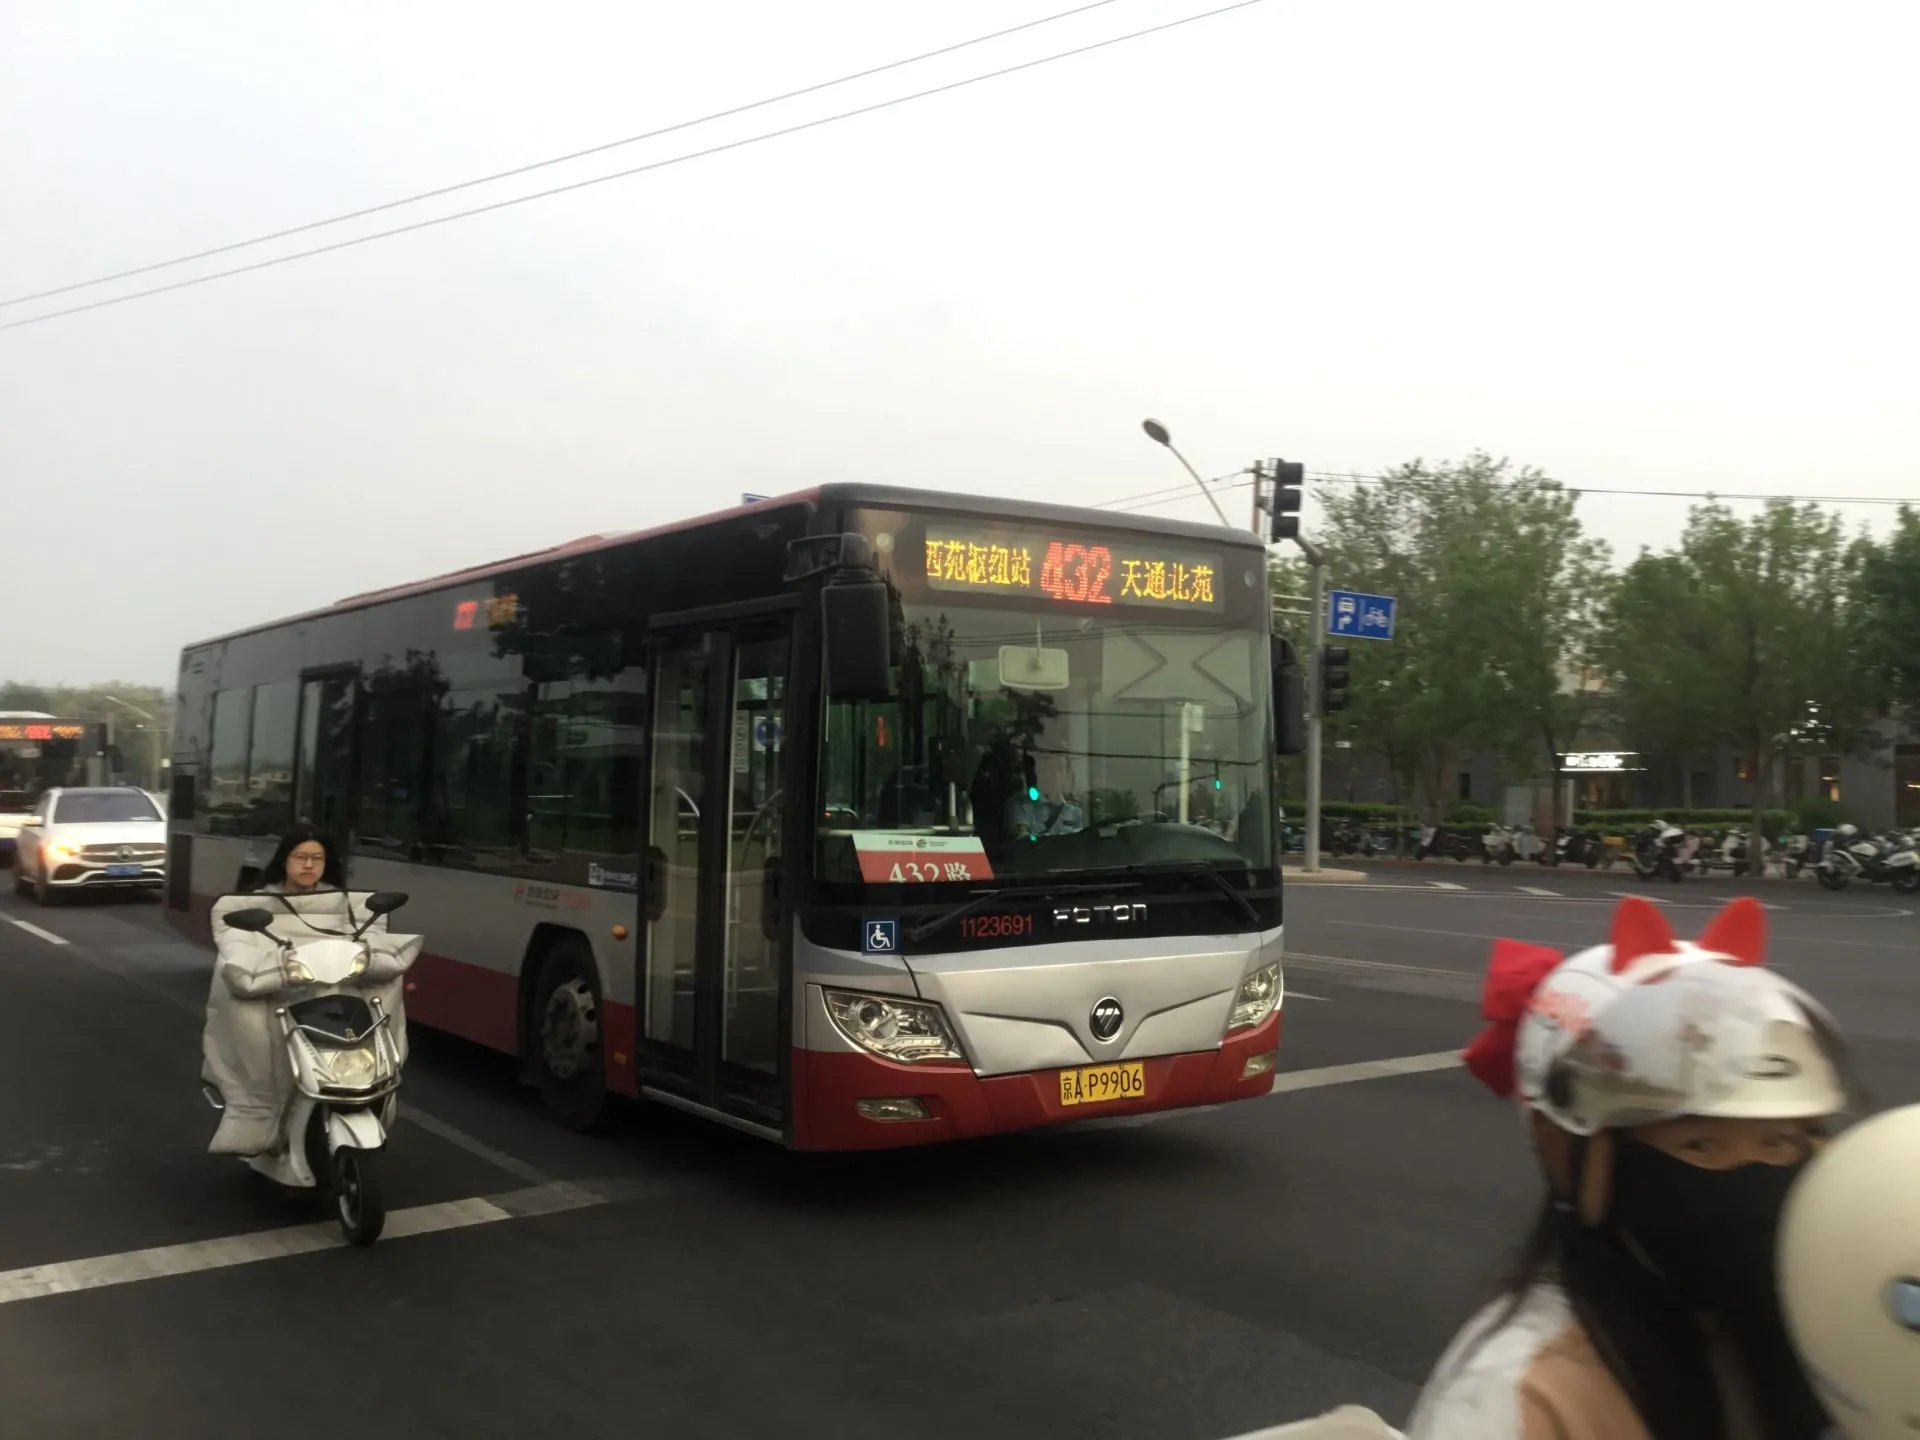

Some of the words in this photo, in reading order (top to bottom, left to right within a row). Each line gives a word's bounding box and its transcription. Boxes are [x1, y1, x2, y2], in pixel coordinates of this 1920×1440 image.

[925, 540, 1031, 587] 西苑枢纽站
[1040, 542, 1111, 603] 432
[1120, 560, 1213, 602] 天通北苑
[960, 914, 1034, 937] 1123691
[1053, 904, 1147, 927] FOTON
